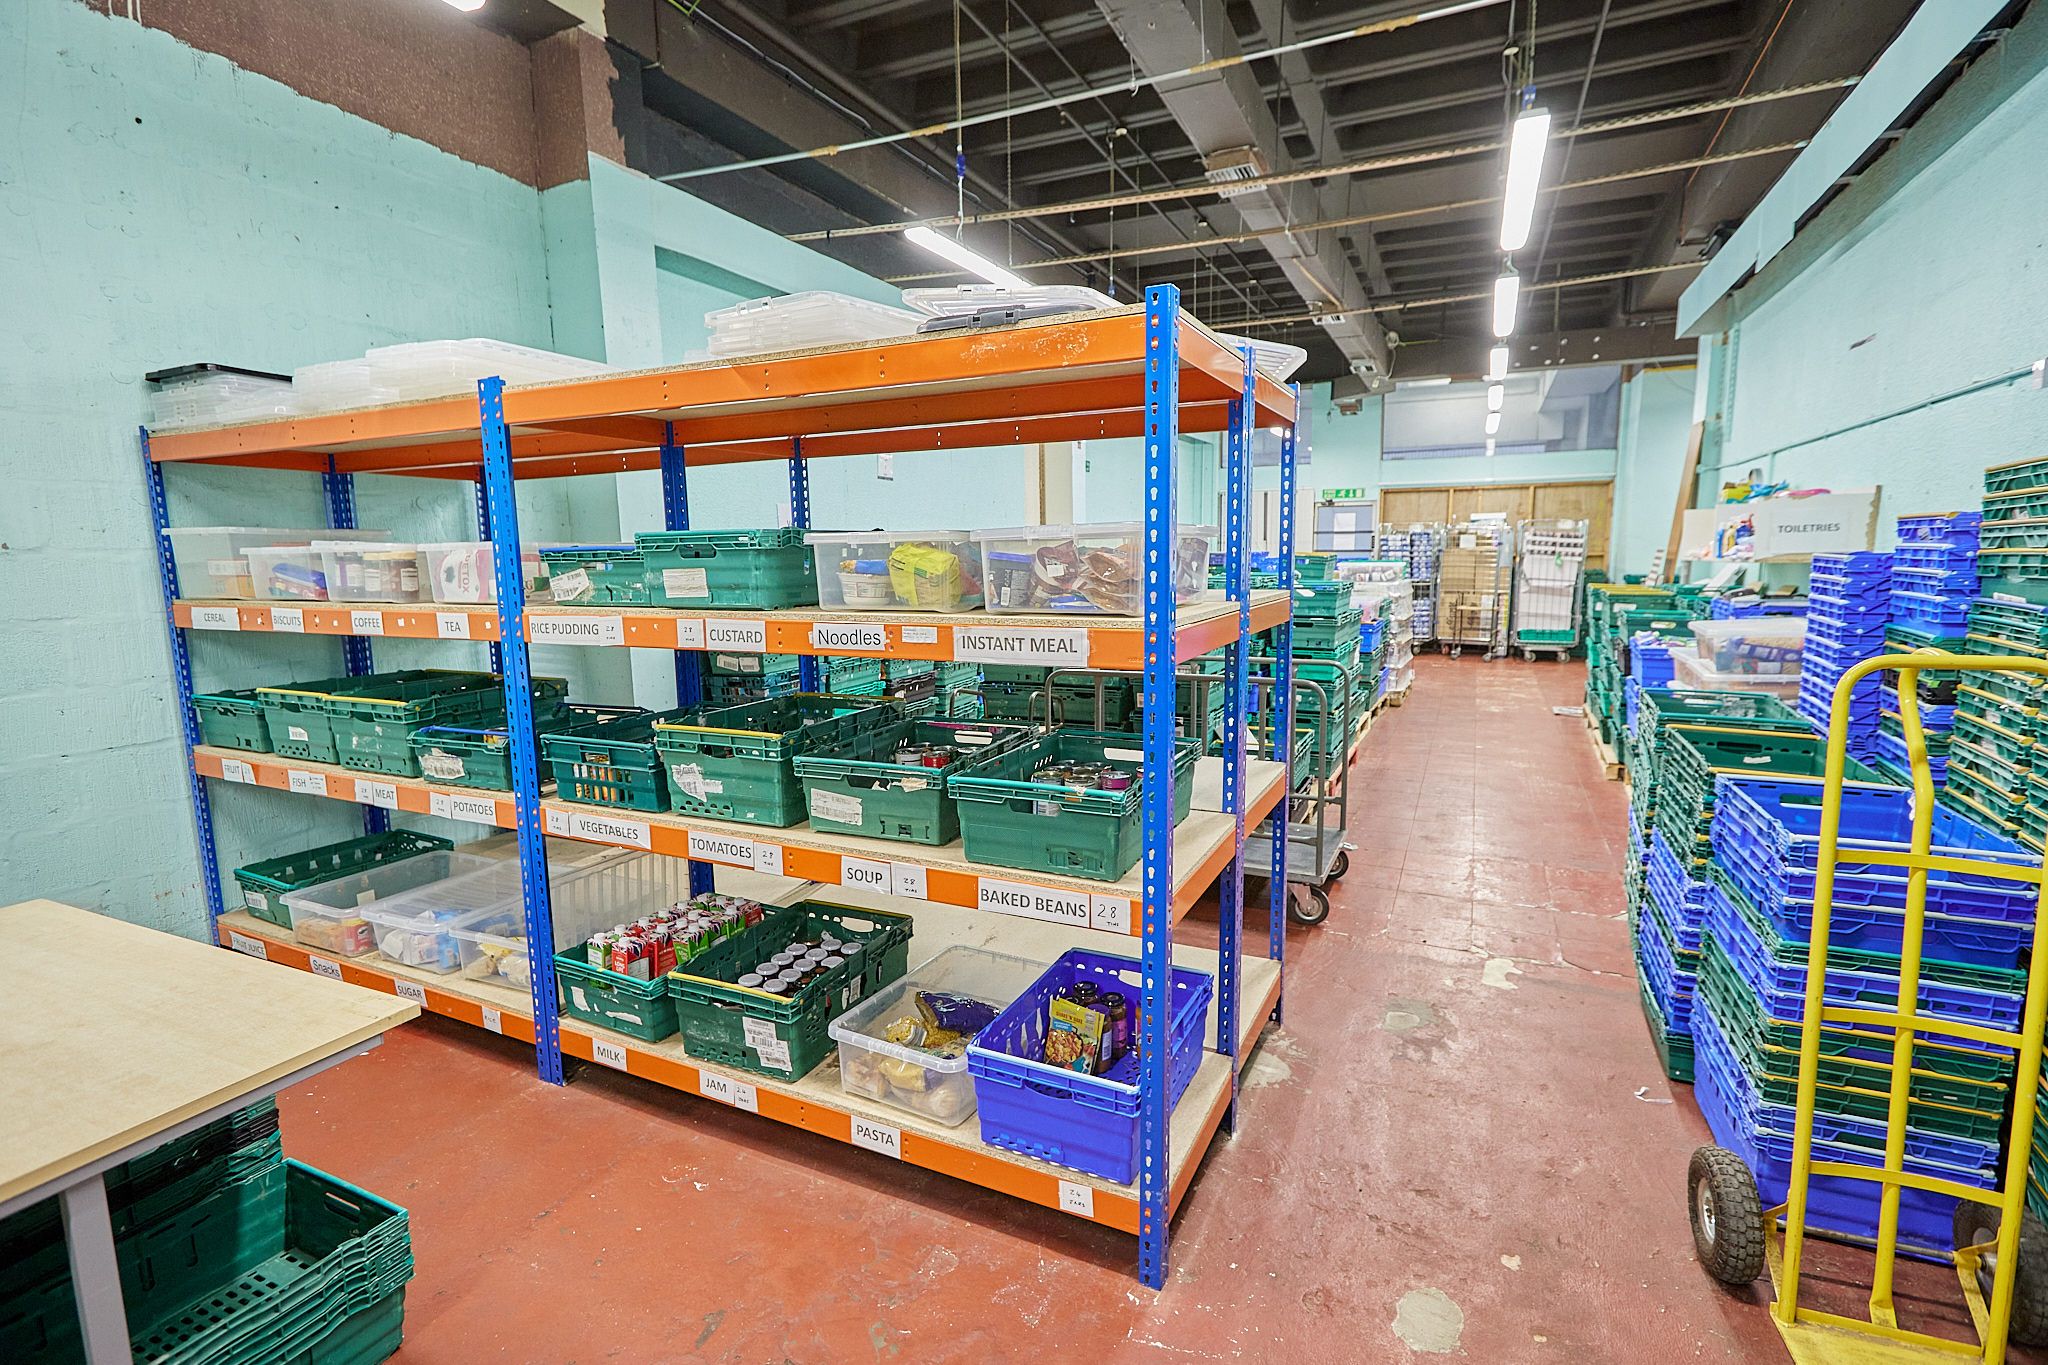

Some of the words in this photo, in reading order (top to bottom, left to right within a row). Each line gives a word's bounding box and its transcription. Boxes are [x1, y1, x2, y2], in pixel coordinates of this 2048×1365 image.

[1777, 521, 1841, 534] TOILETRIES
[203, 611, 226, 623] CEREAL
[273, 614, 301, 626] BISCUITS
[353, 615, 381, 629] COFFEE
[444, 621, 462, 633] TEA
[530, 622, 550, 635] RICE
[552, 622, 599, 636] PUDDING
[709, 628, 763, 644] CUSTARD
[818, 629, 881, 646] Noodles
[961, 635, 1024, 652] INSTANT
[1029, 638, 1078, 654] MEAL
[224, 764, 240, 776] FRUIT
[292, 777, 307, 788] FISH
[375, 788, 395, 801] MEAT
[453, 801, 494, 817] POTATOES
[579, 819, 639, 841] VEGETABLES
[690, 837, 752, 859] TOMATOES
[847, 867, 883, 886] SOUP
[980, 888, 1031, 909] BAKED
[1035, 896, 1087, 918] BEANS
[1097, 903, 1117, 919] 28
[248, 942, 265, 954] JUICE
[313, 959, 340, 978] Snacks
[397, 984, 422, 999] SUGAR
[597, 1046, 621, 1063] MILK
[705, 1079, 728, 1094] JAM
[856, 1124, 895, 1147] PASTA
